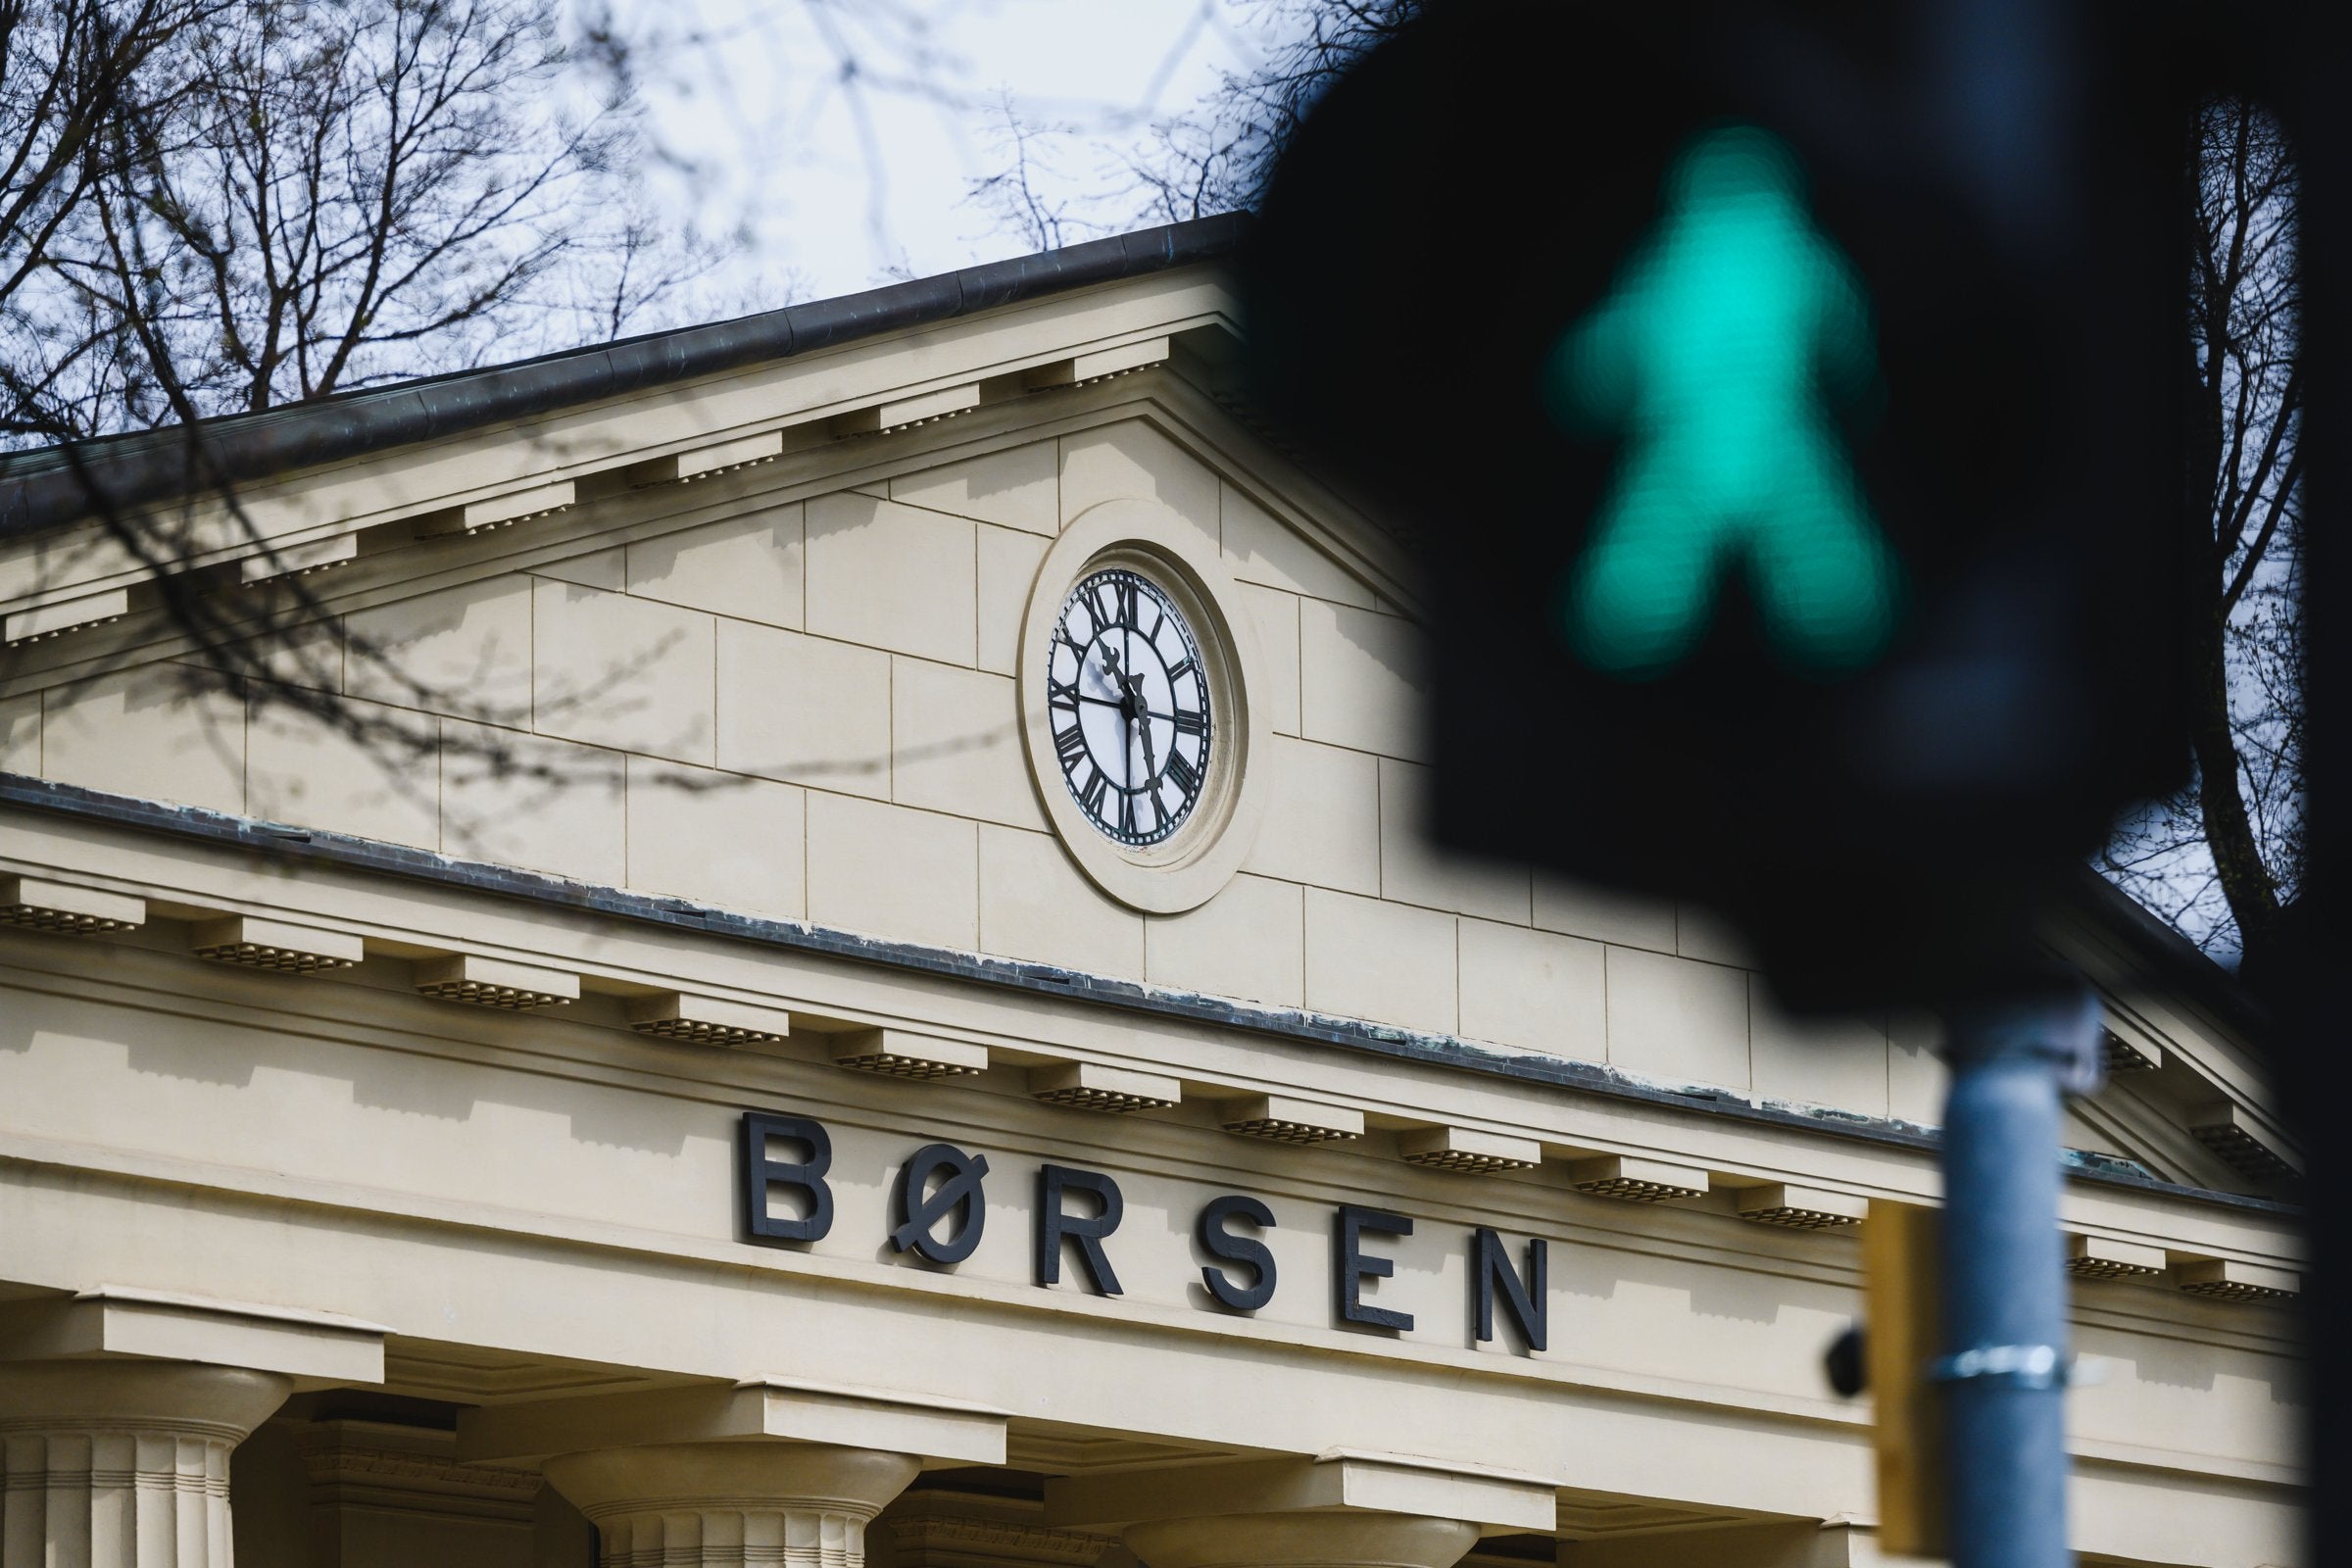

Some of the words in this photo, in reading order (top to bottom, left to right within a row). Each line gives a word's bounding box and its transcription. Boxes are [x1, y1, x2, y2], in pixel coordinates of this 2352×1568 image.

[1079, 587, 1109, 634] XI
[1113, 581, 1139, 628] XII
[1056, 621, 1090, 660] X
[1168, 656, 1195, 682] II
[1049, 678, 1080, 712] IX
[1176, 709, 1201, 736] III
[1056, 725, 1089, 776] VIII
[1166, 749, 1197, 798] IIII
[1081, 768, 1108, 820] VII
[1118, 788, 1138, 835] VI
[742, 1111, 1547, 1351] BØRSEN
